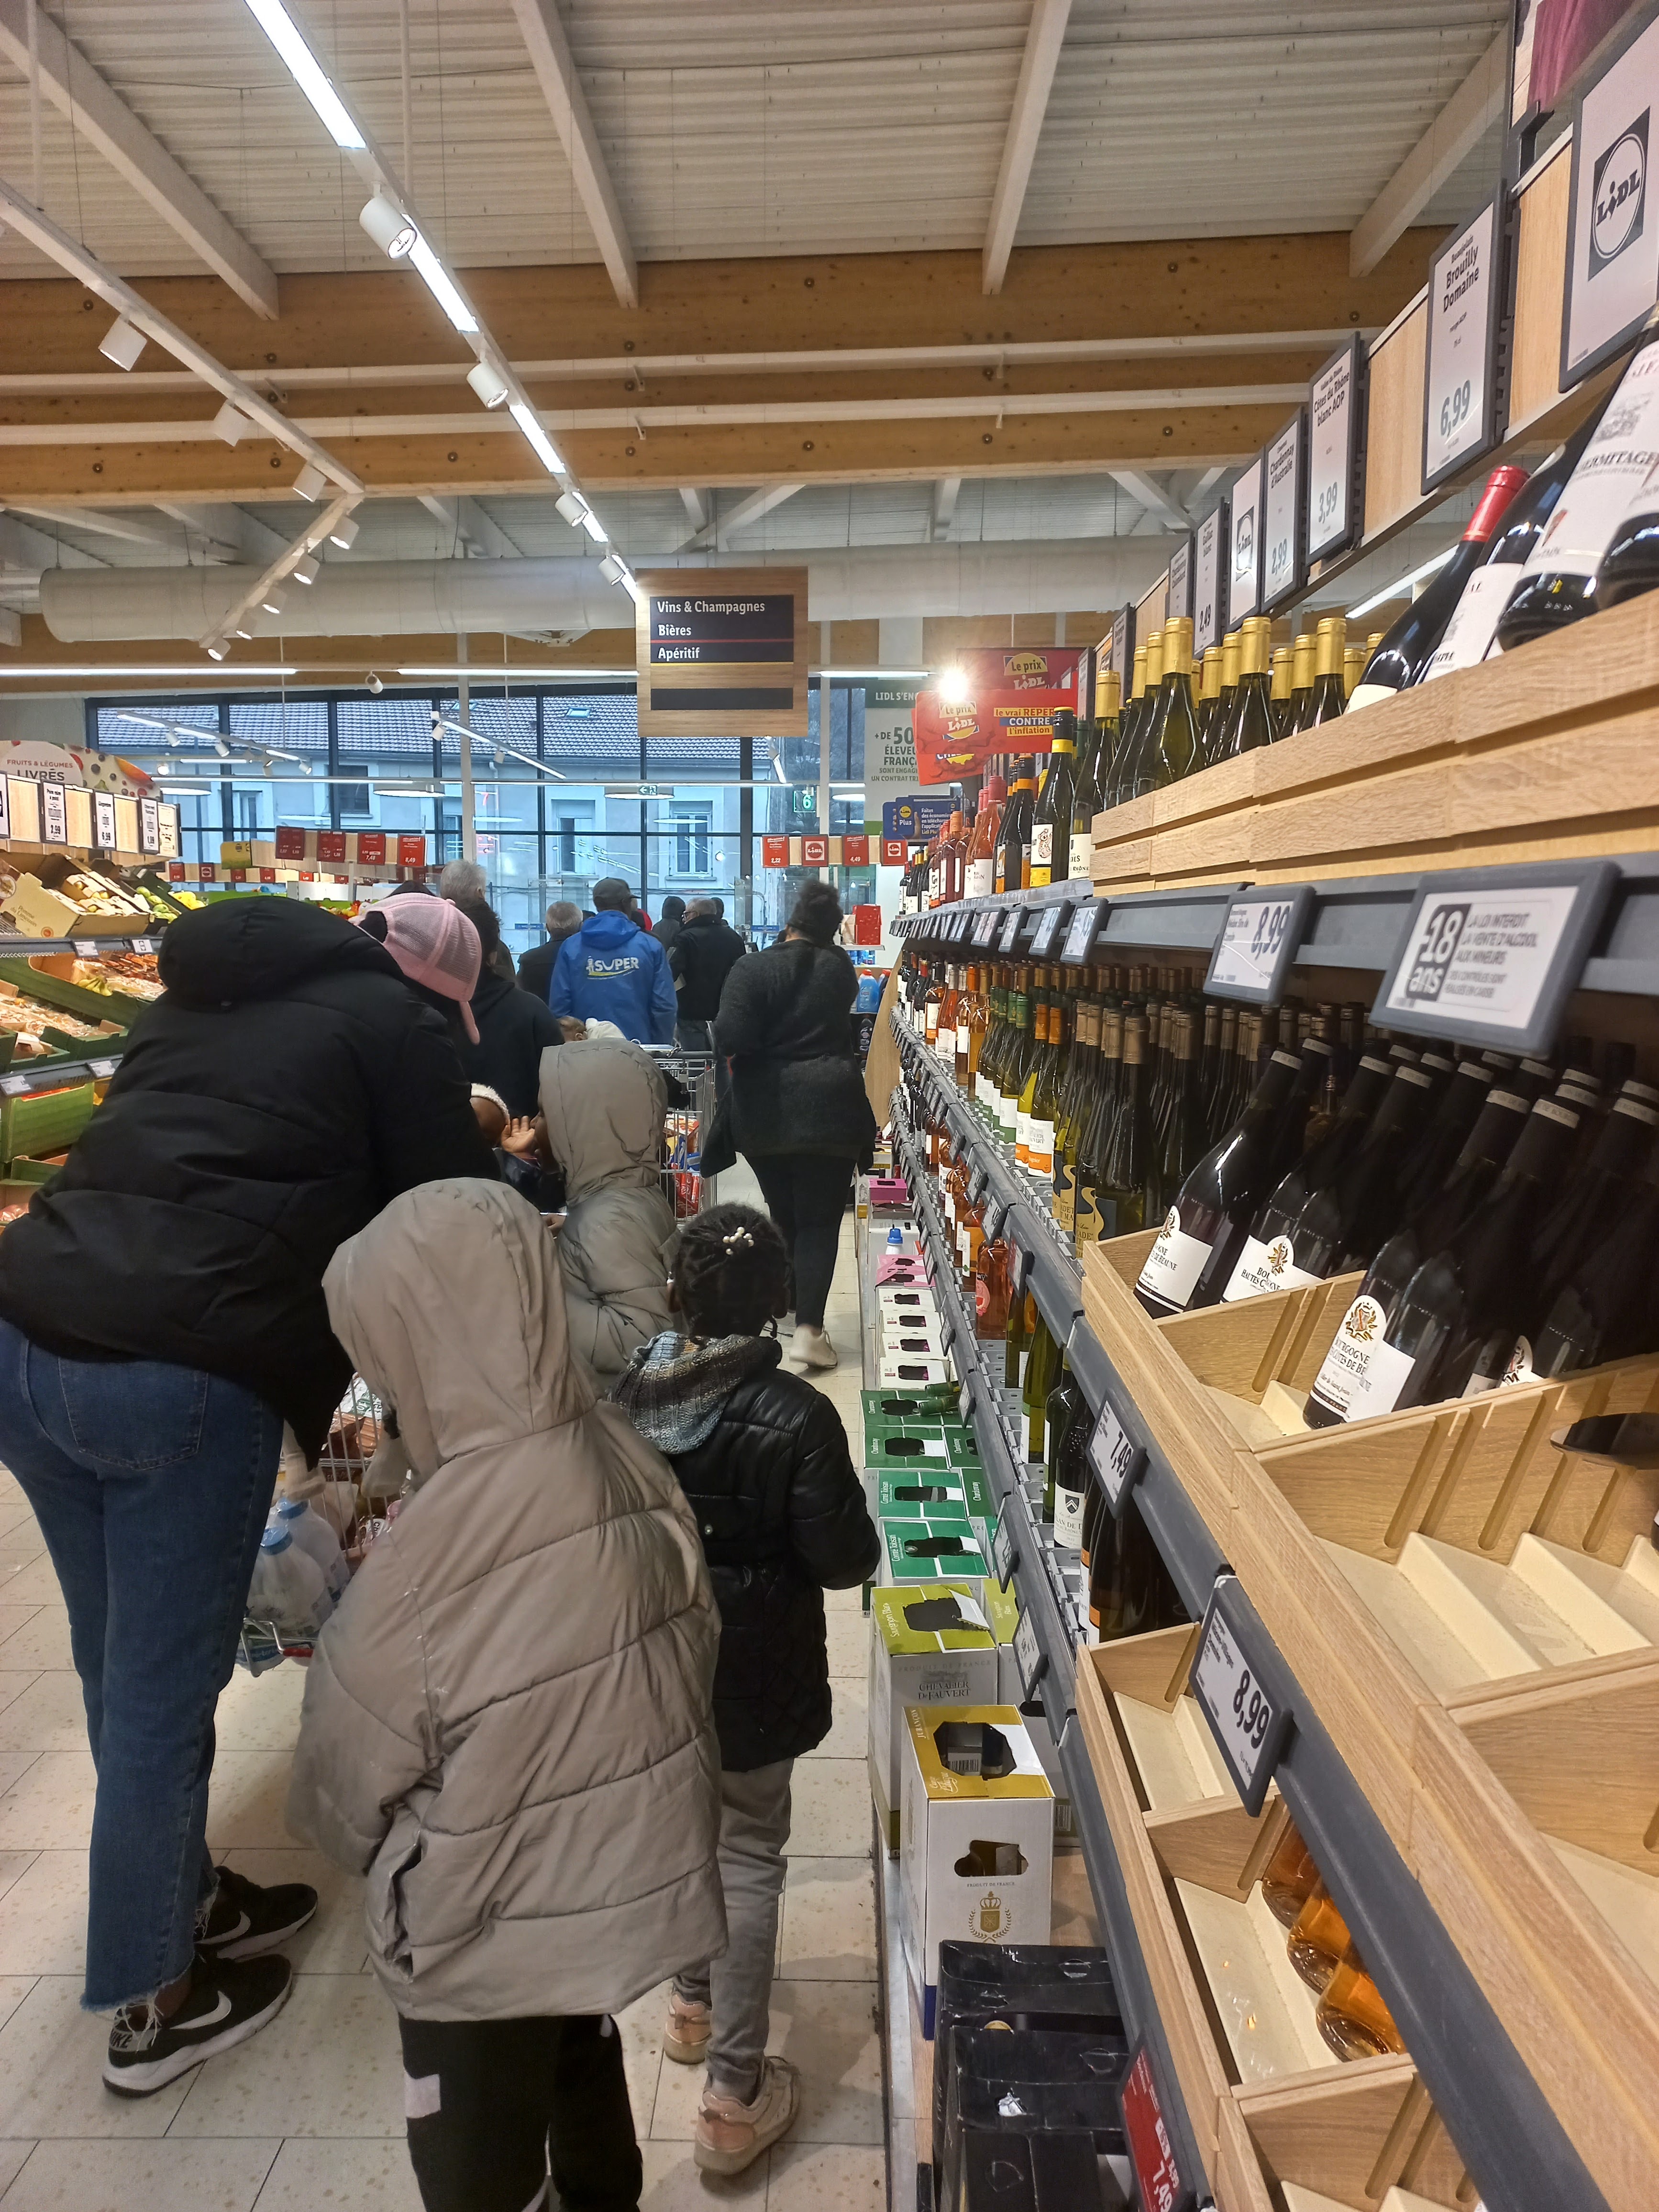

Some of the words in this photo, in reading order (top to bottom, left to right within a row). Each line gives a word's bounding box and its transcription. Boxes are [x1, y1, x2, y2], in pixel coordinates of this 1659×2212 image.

[1447, 246, 1478, 289] Brouilly
[1444, 267, 1479, 313] Domaine
[1315, 395, 1326, 413] Côtes
[1327, 387, 1333, 400] du
[1335, 373, 1349, 394] Rhône
[1318, 407, 1331, 427] blanc
[1332, 390, 1345, 413] AOP
[1440, 379, 1470, 437] 6,99
[1271, 443, 1294, 475] Chardonnay
[1319, 482, 1338, 524] 3,99
[1272, 538, 1287, 574] 2,99
[657, 601, 681, 613] Vins
[685, 602, 692, 613] &
[695, 601, 765, 615] Champagnes
[1199, 604, 1211, 633] 2,49
[658, 624, 691, 636] Bières
[658, 647, 699, 661] Apéritif
[1012, 662, 1021, 671] Le
[1023, 660, 1041, 673] prix
[875, 692, 895, 700] LIDL
[896, 692, 916, 700] S'EN
[946, 706, 954, 714] Le
[956, 705, 972, 715] prix
[1009, 718, 1050, 726] CONTRE
[1009, 726, 1050, 735] l'inflation
[40, 760, 73, 768] LÉGUMES
[884, 757, 918, 767] FRANÇ
[17, 768, 65, 781] LIVRÉS
[803, 794, 812, 809] 6
[1251, 906, 1290, 961] 8,99
[1408, 966, 1444, 994] ans
[871, 1438, 880, 1454] Chardonnay
[1110, 1430, 1132, 1478] 7,49
[972, 1482, 981, 1501] Chardonnay
[919, 1681, 970, 1692] CHEVALIER
[928, 1689, 971, 1700] FAUVERT
[1233, 1670, 1270, 1749] 8,99
[911, 1709, 926, 1738] JURANÇON
